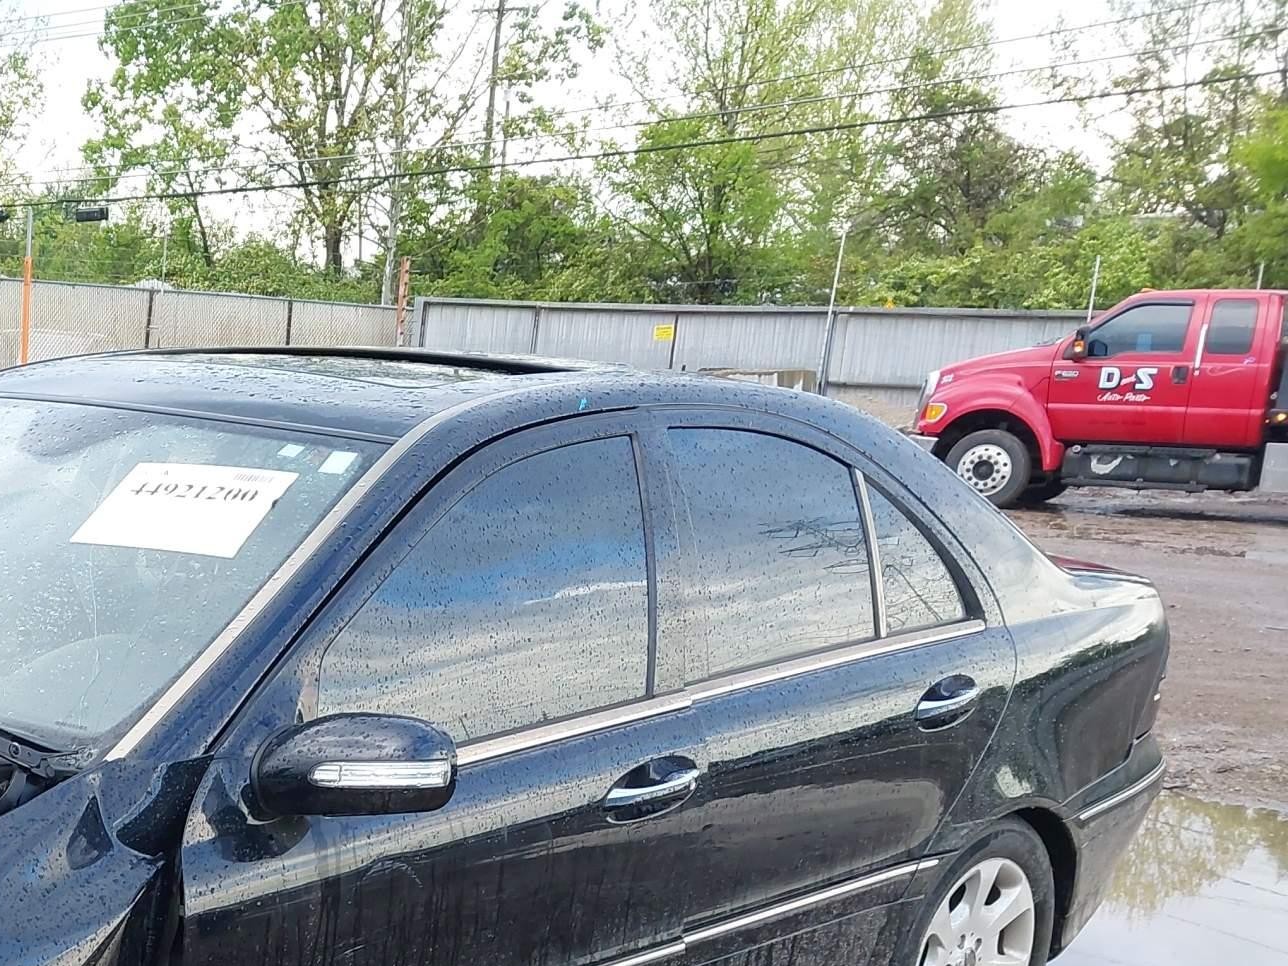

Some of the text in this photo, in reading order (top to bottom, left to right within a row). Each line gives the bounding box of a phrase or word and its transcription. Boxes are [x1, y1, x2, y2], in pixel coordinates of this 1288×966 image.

[1098, 366, 1121, 389] D
[1134, 367, 1159, 390] S
[130, 482, 259, 502] 44921200
